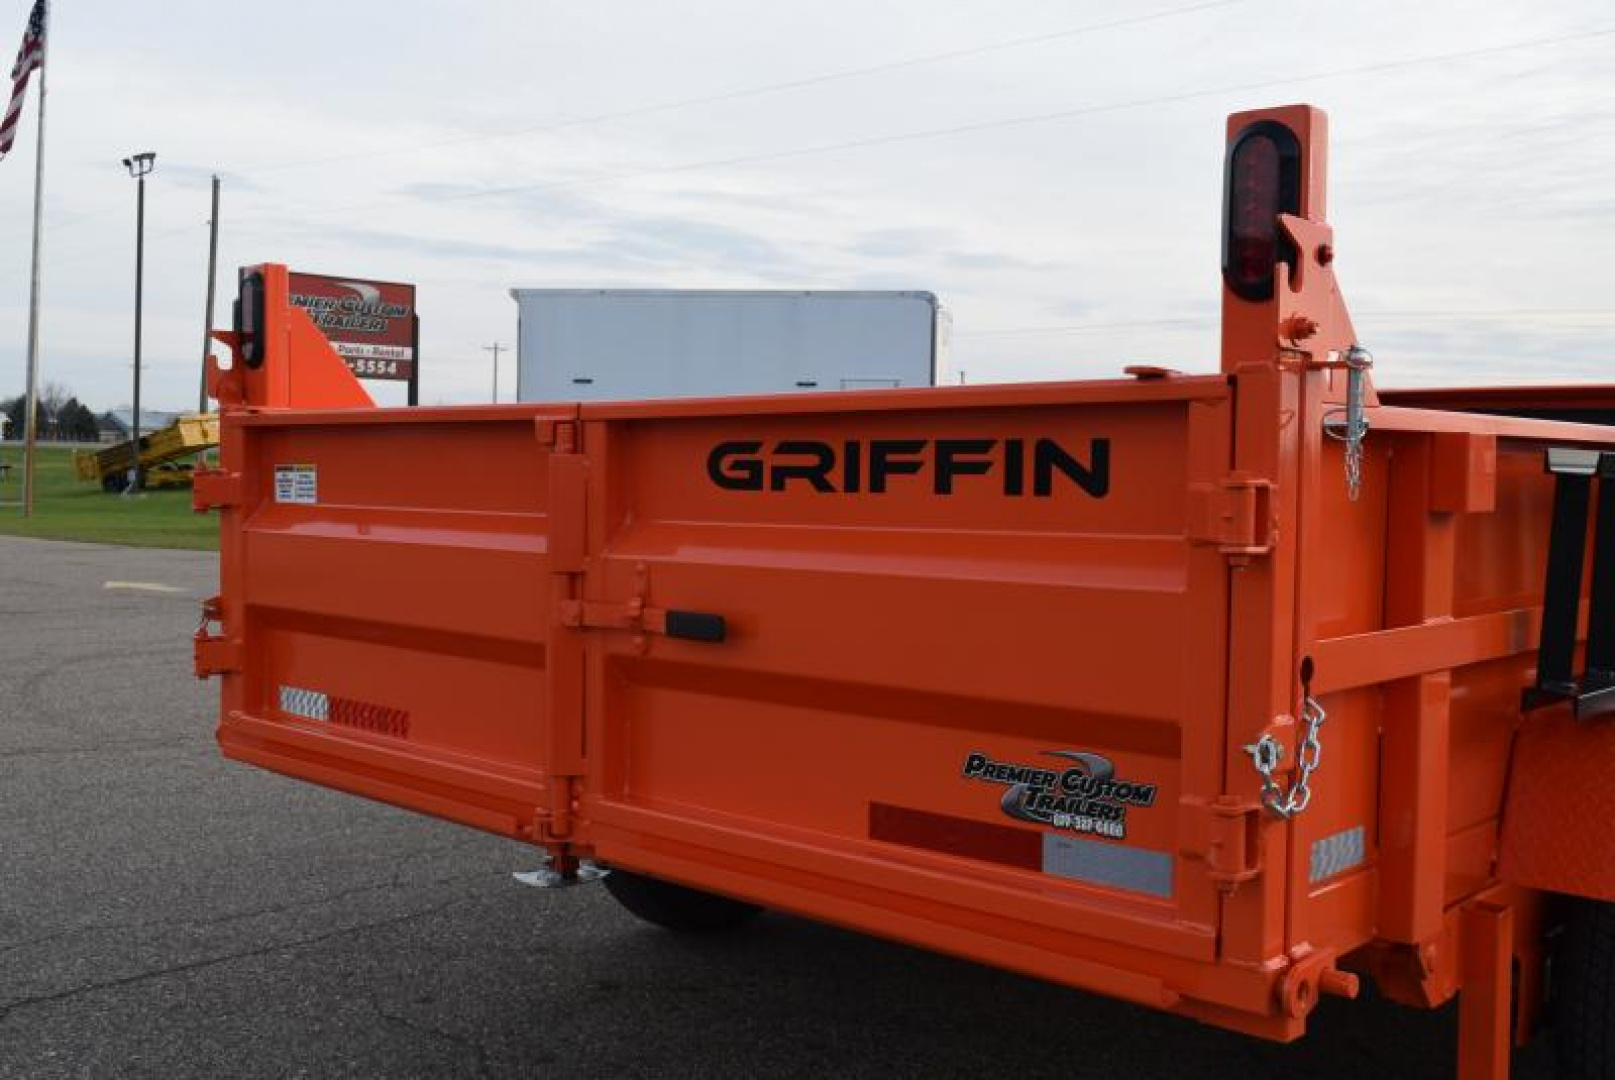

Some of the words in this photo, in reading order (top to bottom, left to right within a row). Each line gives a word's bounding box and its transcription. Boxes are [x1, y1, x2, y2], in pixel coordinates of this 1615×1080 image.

[706, 437, 1111, 499] GRIFFIN
[964, 754, 1058, 786] PREMIER
[1060, 766, 1155, 805] CUSTOM
[1022, 785, 1125, 820] TRAILERS
